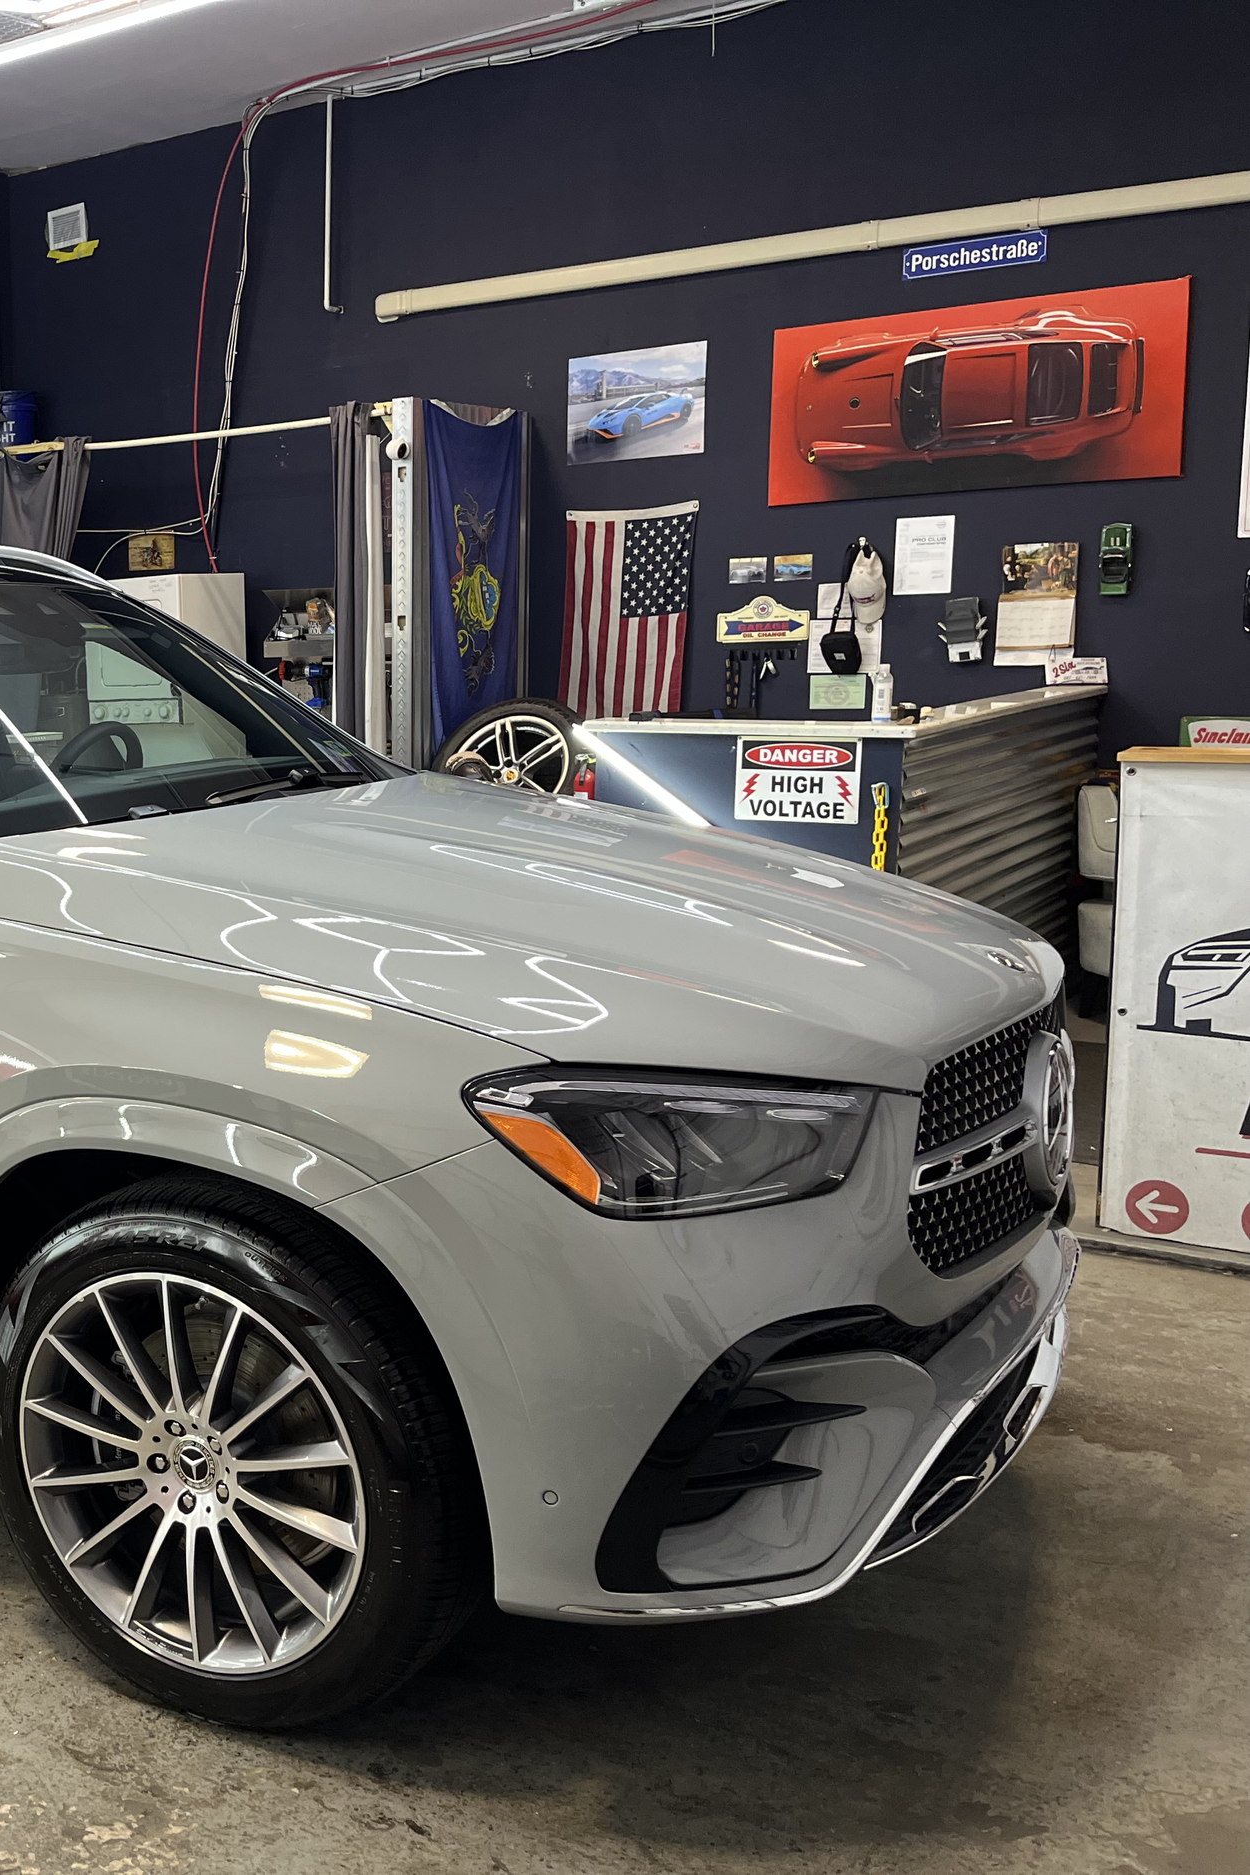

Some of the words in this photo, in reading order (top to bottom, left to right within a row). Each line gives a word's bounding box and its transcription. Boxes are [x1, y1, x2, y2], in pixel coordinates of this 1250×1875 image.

[911, 239, 1038, 272] Porschestraße
[3, 421, 15, 432] IT
[737, 620, 789, 632] GARAGE
[759, 748, 838, 763] DANGER
[771, 775, 823, 794] HIGH
[749, 799, 845, 819] VOLTAGE
[156, 1230, 207, 1252] R21
